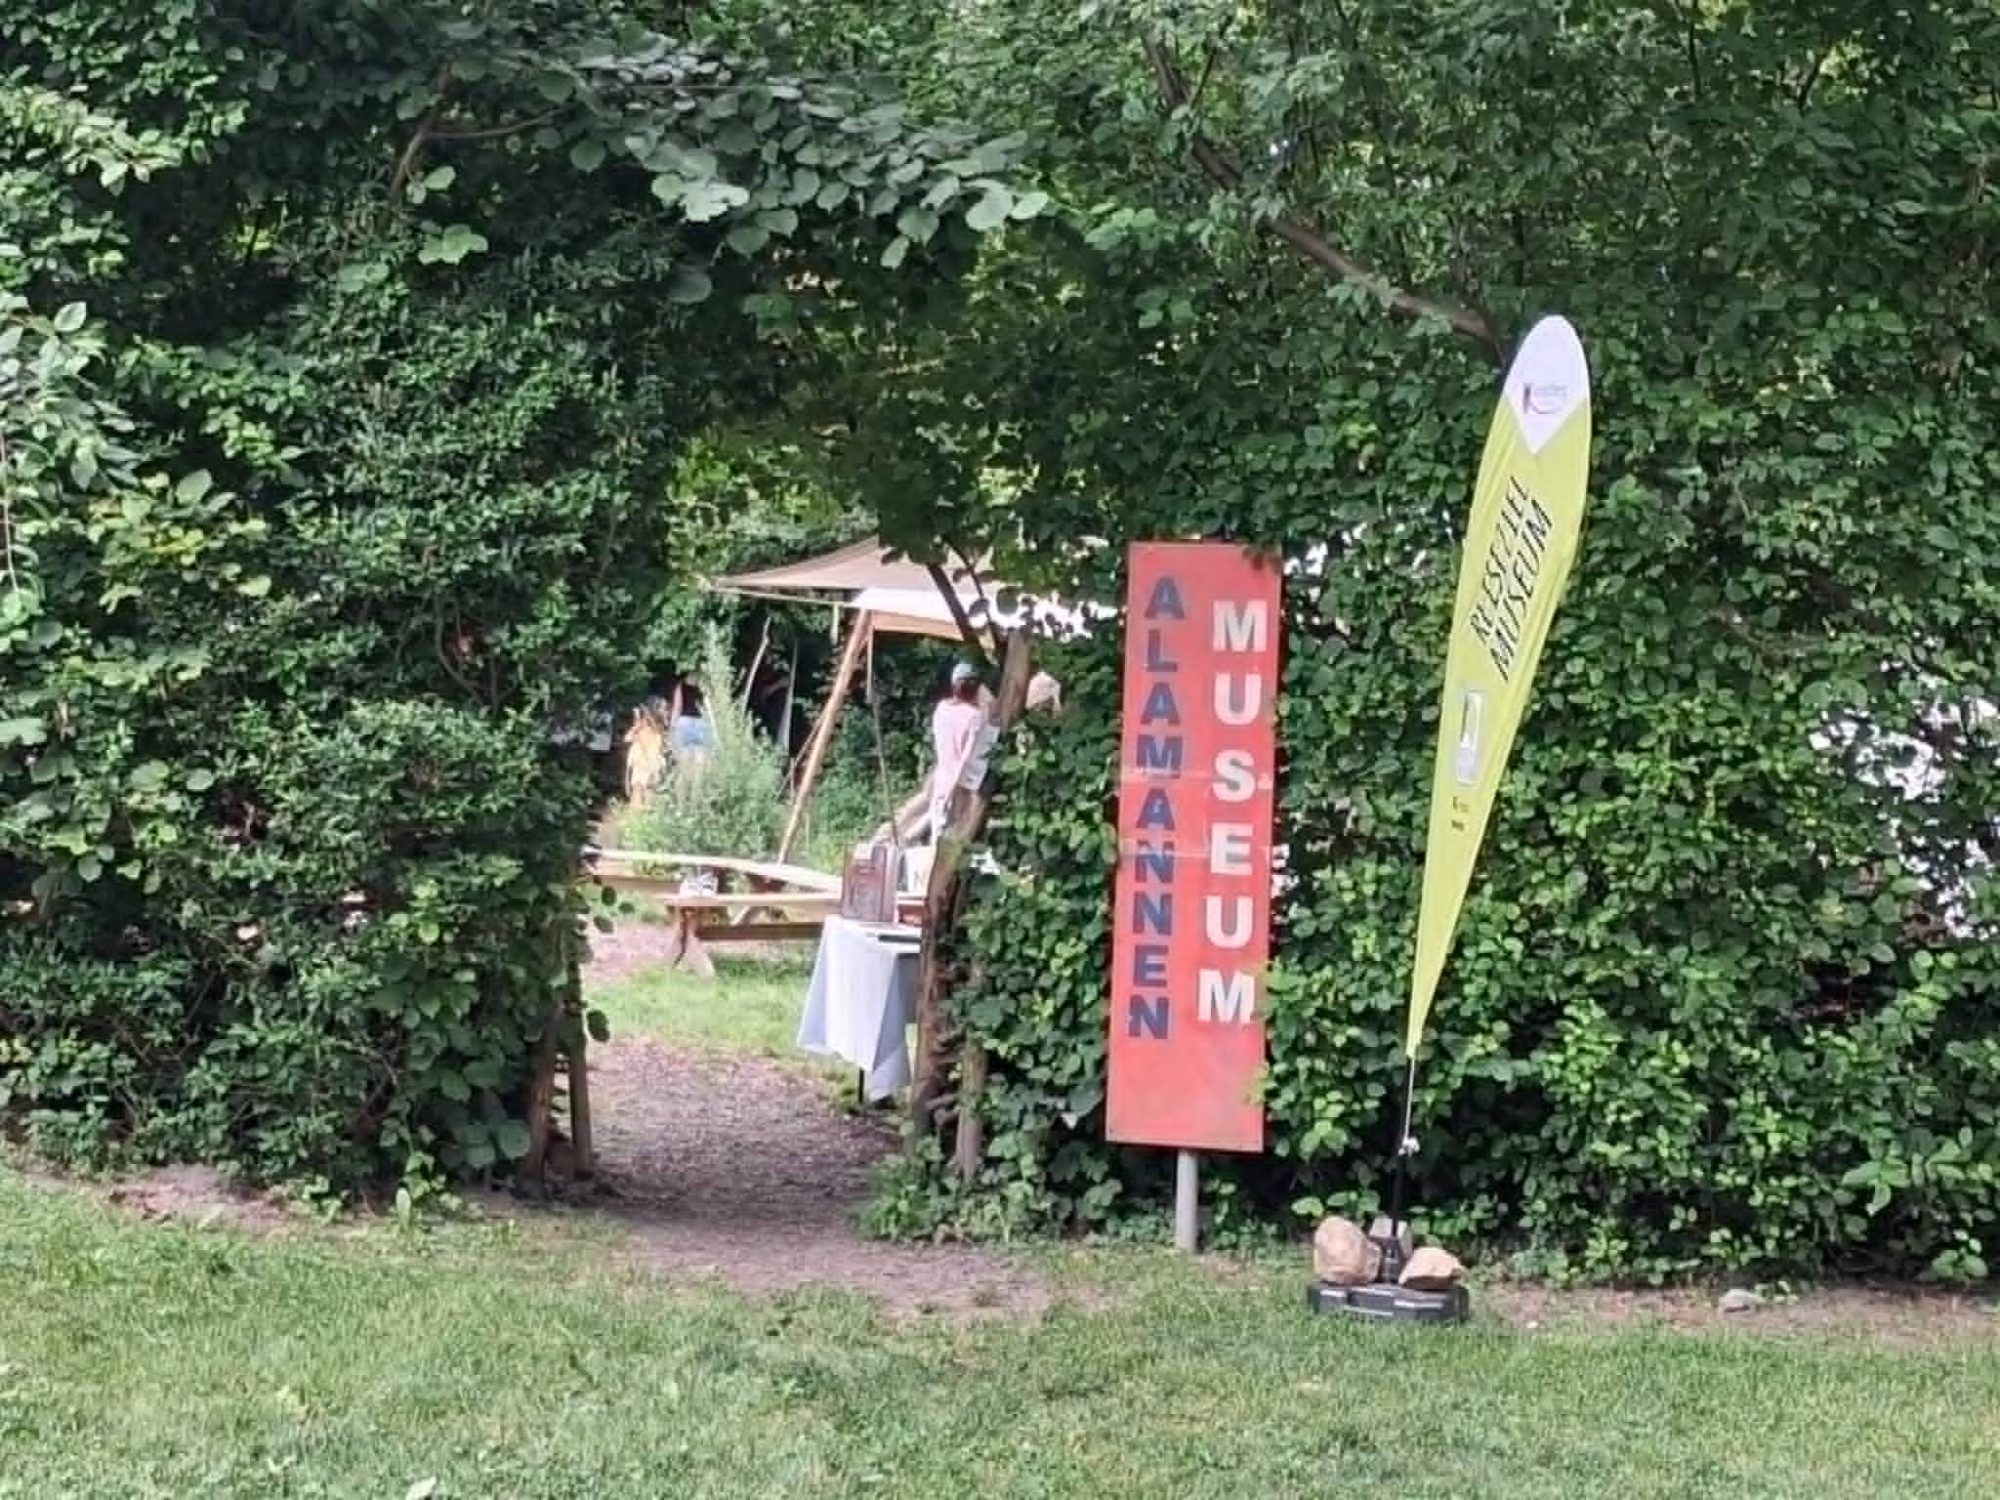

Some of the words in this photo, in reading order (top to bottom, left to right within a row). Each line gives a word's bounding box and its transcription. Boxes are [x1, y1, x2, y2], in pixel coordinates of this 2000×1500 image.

[1490, 499, 1552, 682] MUSEUM
[1128, 576, 1185, 1040] ALAMANNEN
[1197, 599, 1268, 1024] MUSEUM
